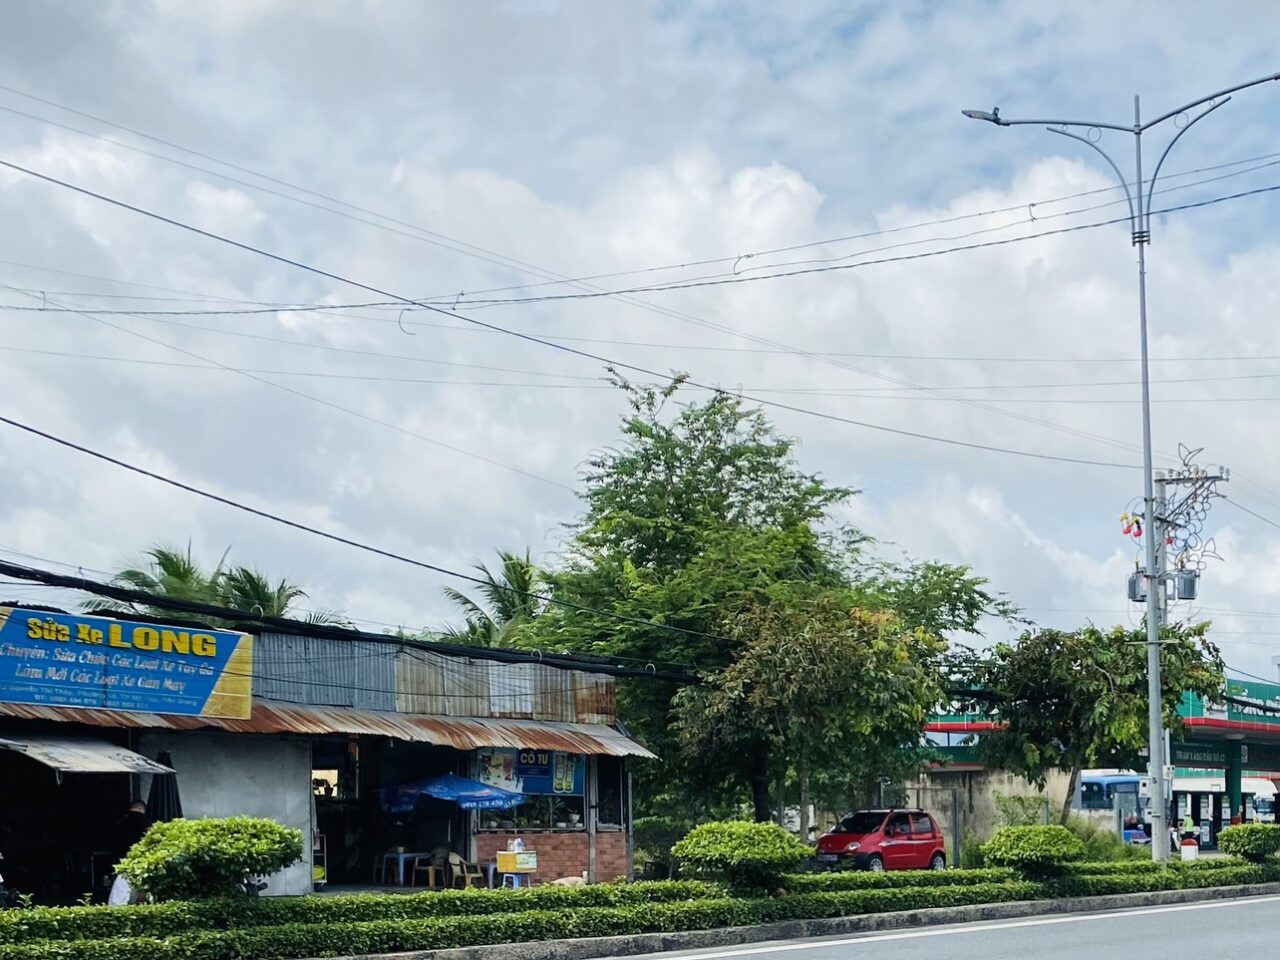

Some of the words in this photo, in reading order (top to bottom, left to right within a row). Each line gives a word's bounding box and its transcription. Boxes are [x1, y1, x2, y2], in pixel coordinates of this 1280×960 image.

[27, 617, 70, 642] Sửa
[75, 622, 103, 645] Xe
[108, 623, 217, 657] LONG
[520, 751, 535, 764] CÔ
